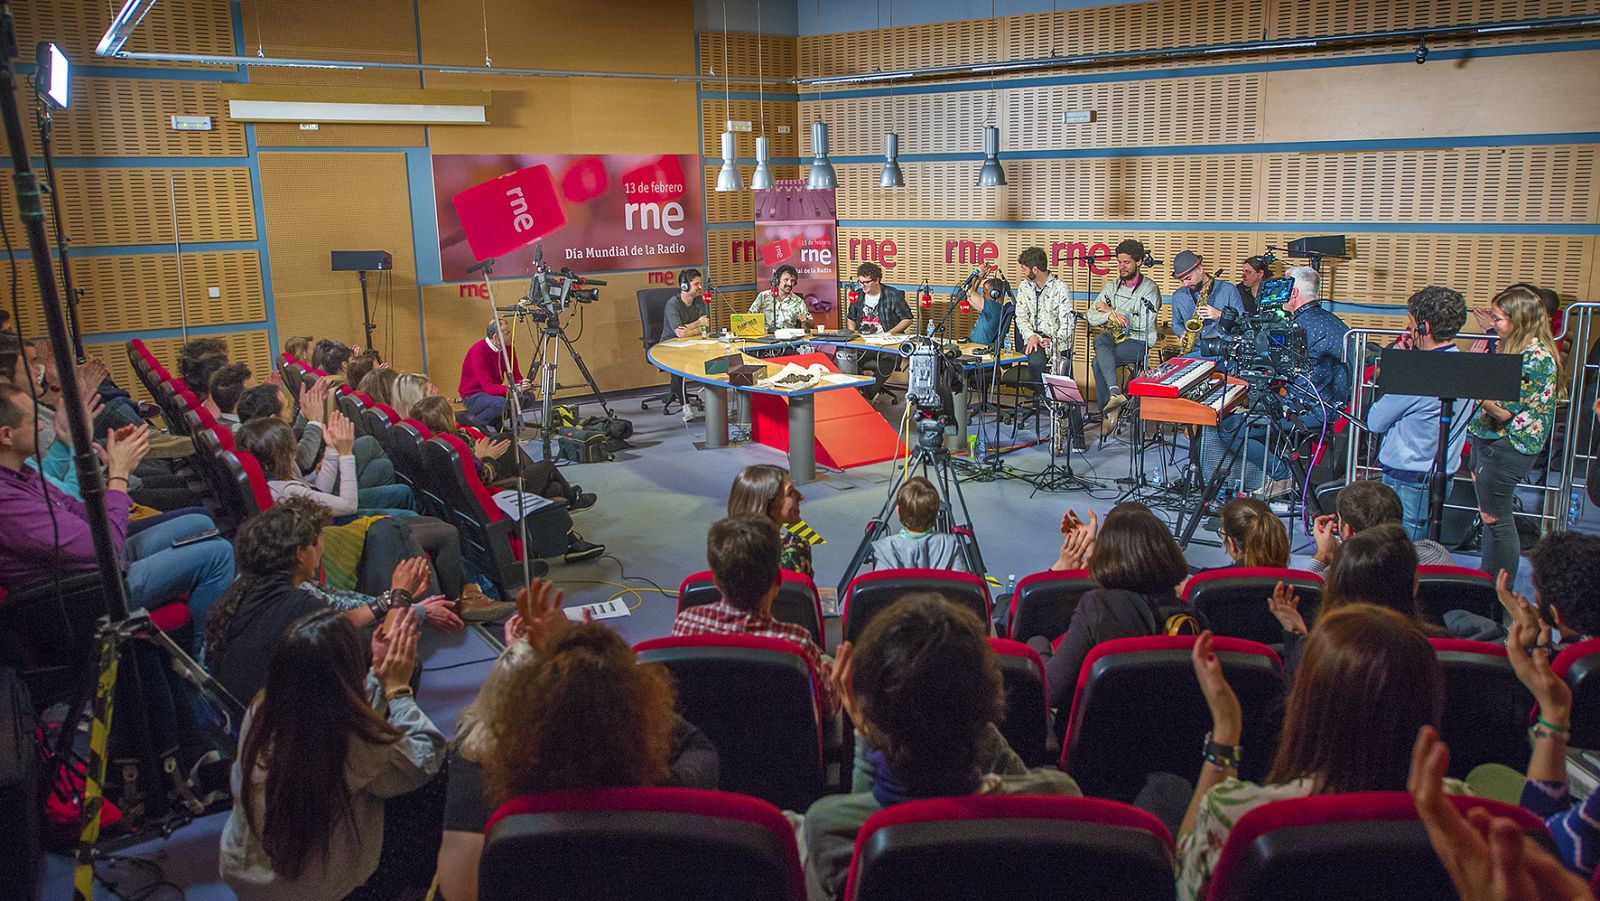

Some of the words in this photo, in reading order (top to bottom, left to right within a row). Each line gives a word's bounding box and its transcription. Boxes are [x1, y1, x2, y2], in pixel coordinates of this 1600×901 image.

[625, 182, 636, 193] 13
[638, 181, 649, 193] de
[651, 181, 683, 193] febrero
[506, 186, 534, 232] rne
[625, 202, 685, 237] rne
[565, 248, 583, 260] Día
[586, 246, 629, 258] Mundial
[631, 245, 643, 256] de
[645, 244, 655, 255] la
[657, 243, 686, 254] Radio
[732, 240, 756, 263] rn
[801, 248, 832, 265] rne
[849, 238, 897, 269] rne
[946, 240, 999, 272] rne
[1051, 242, 1112, 276] rne
[648, 270, 674, 286] rne
[459, 283, 490, 299] rne
